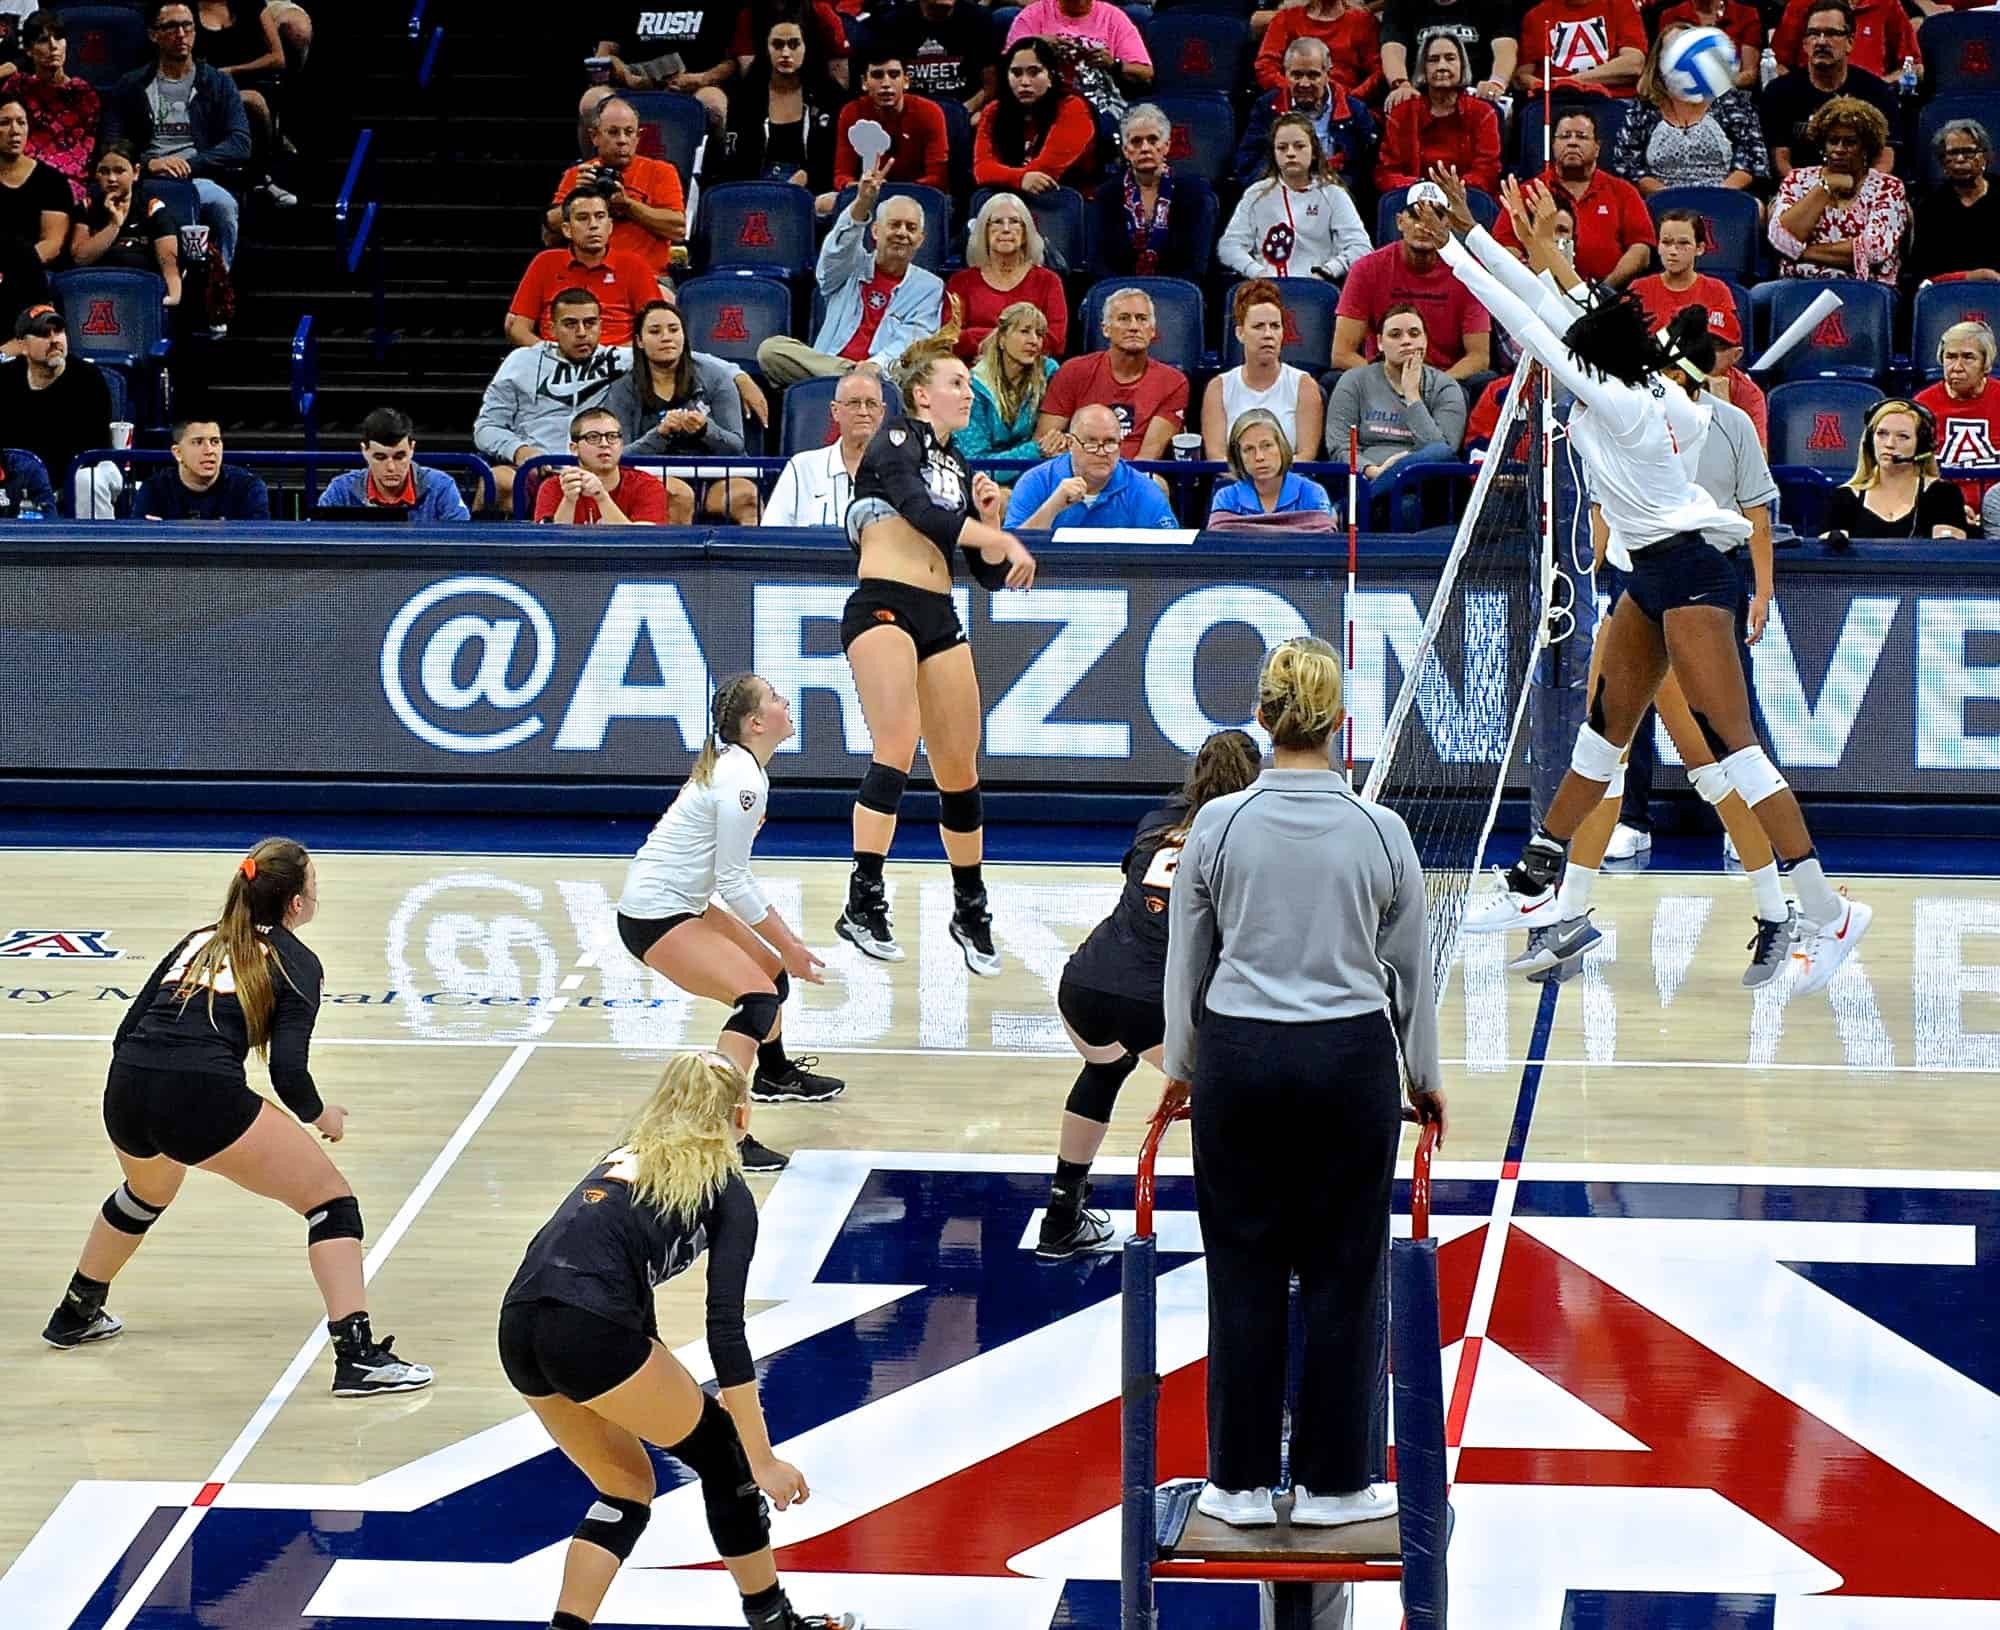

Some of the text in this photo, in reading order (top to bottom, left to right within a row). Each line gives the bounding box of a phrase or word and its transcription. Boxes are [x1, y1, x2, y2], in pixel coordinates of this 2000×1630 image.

[637, 11, 704, 35] RUSH
[906, 62, 961, 79] SWEET
[82, 299, 121, 335] A
[1807, 411, 1847, 451] A
